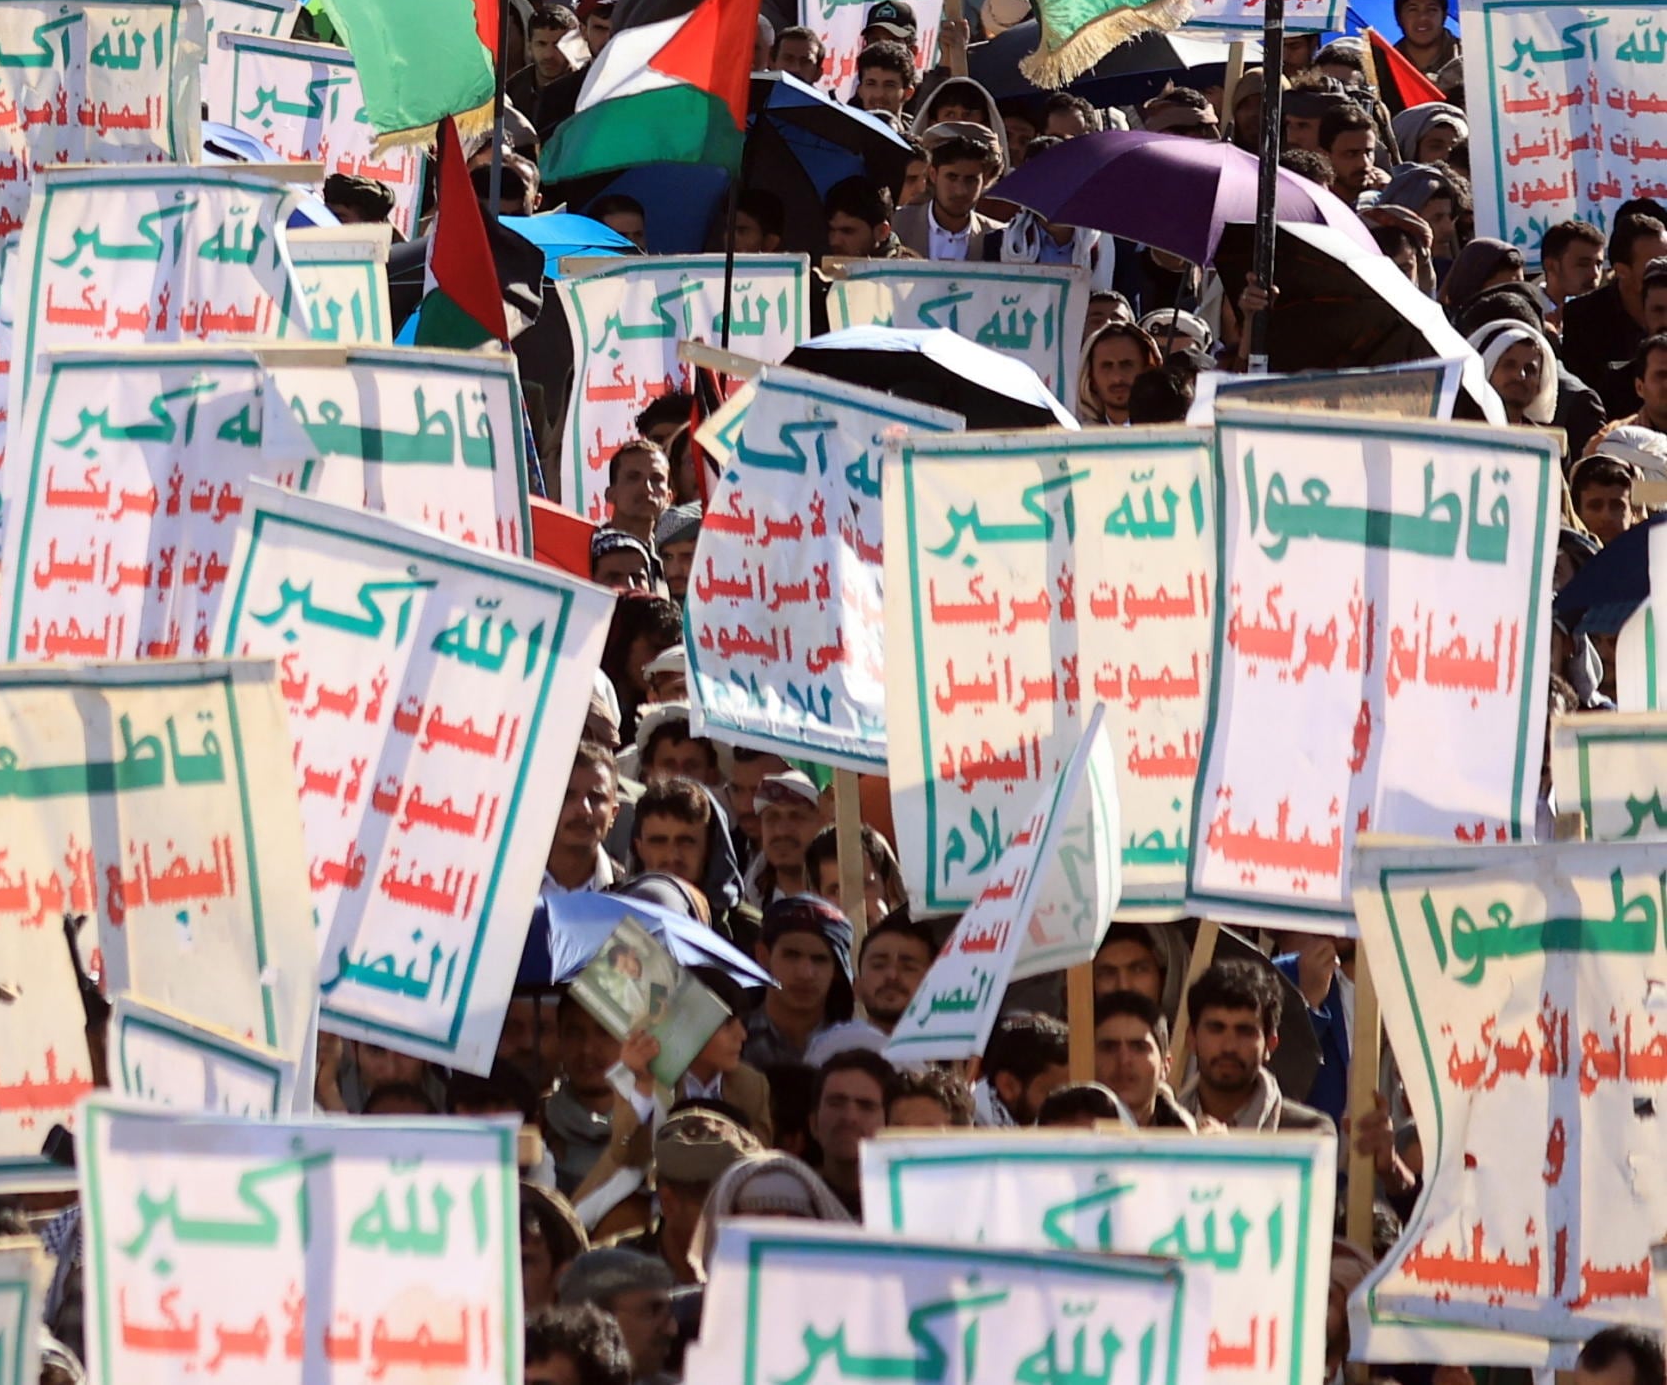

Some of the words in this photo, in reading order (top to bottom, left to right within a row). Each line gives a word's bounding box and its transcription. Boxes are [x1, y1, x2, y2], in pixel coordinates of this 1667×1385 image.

[924, 460, 1091, 568] أكبر
[1103, 467, 1204, 540] الله
[1242, 446, 1511, 566] قاطعوا
[250, 564, 438, 649] أكبر
[430, 594, 544, 682] الله
[1089, 569, 1209, 630] الموت
[393, 690, 520, 764] الموت
[939, 719, 1042, 795] اليهود
[372, 774, 499, 843] الموت
[379, 847, 479, 921] اللعنة
[116, 1134, 335, 1277] أكبر
[348, 1155, 489, 1258] الله
[1148, 1184, 1284, 1274] الله
[322, 1303, 489, 1380] الموت
